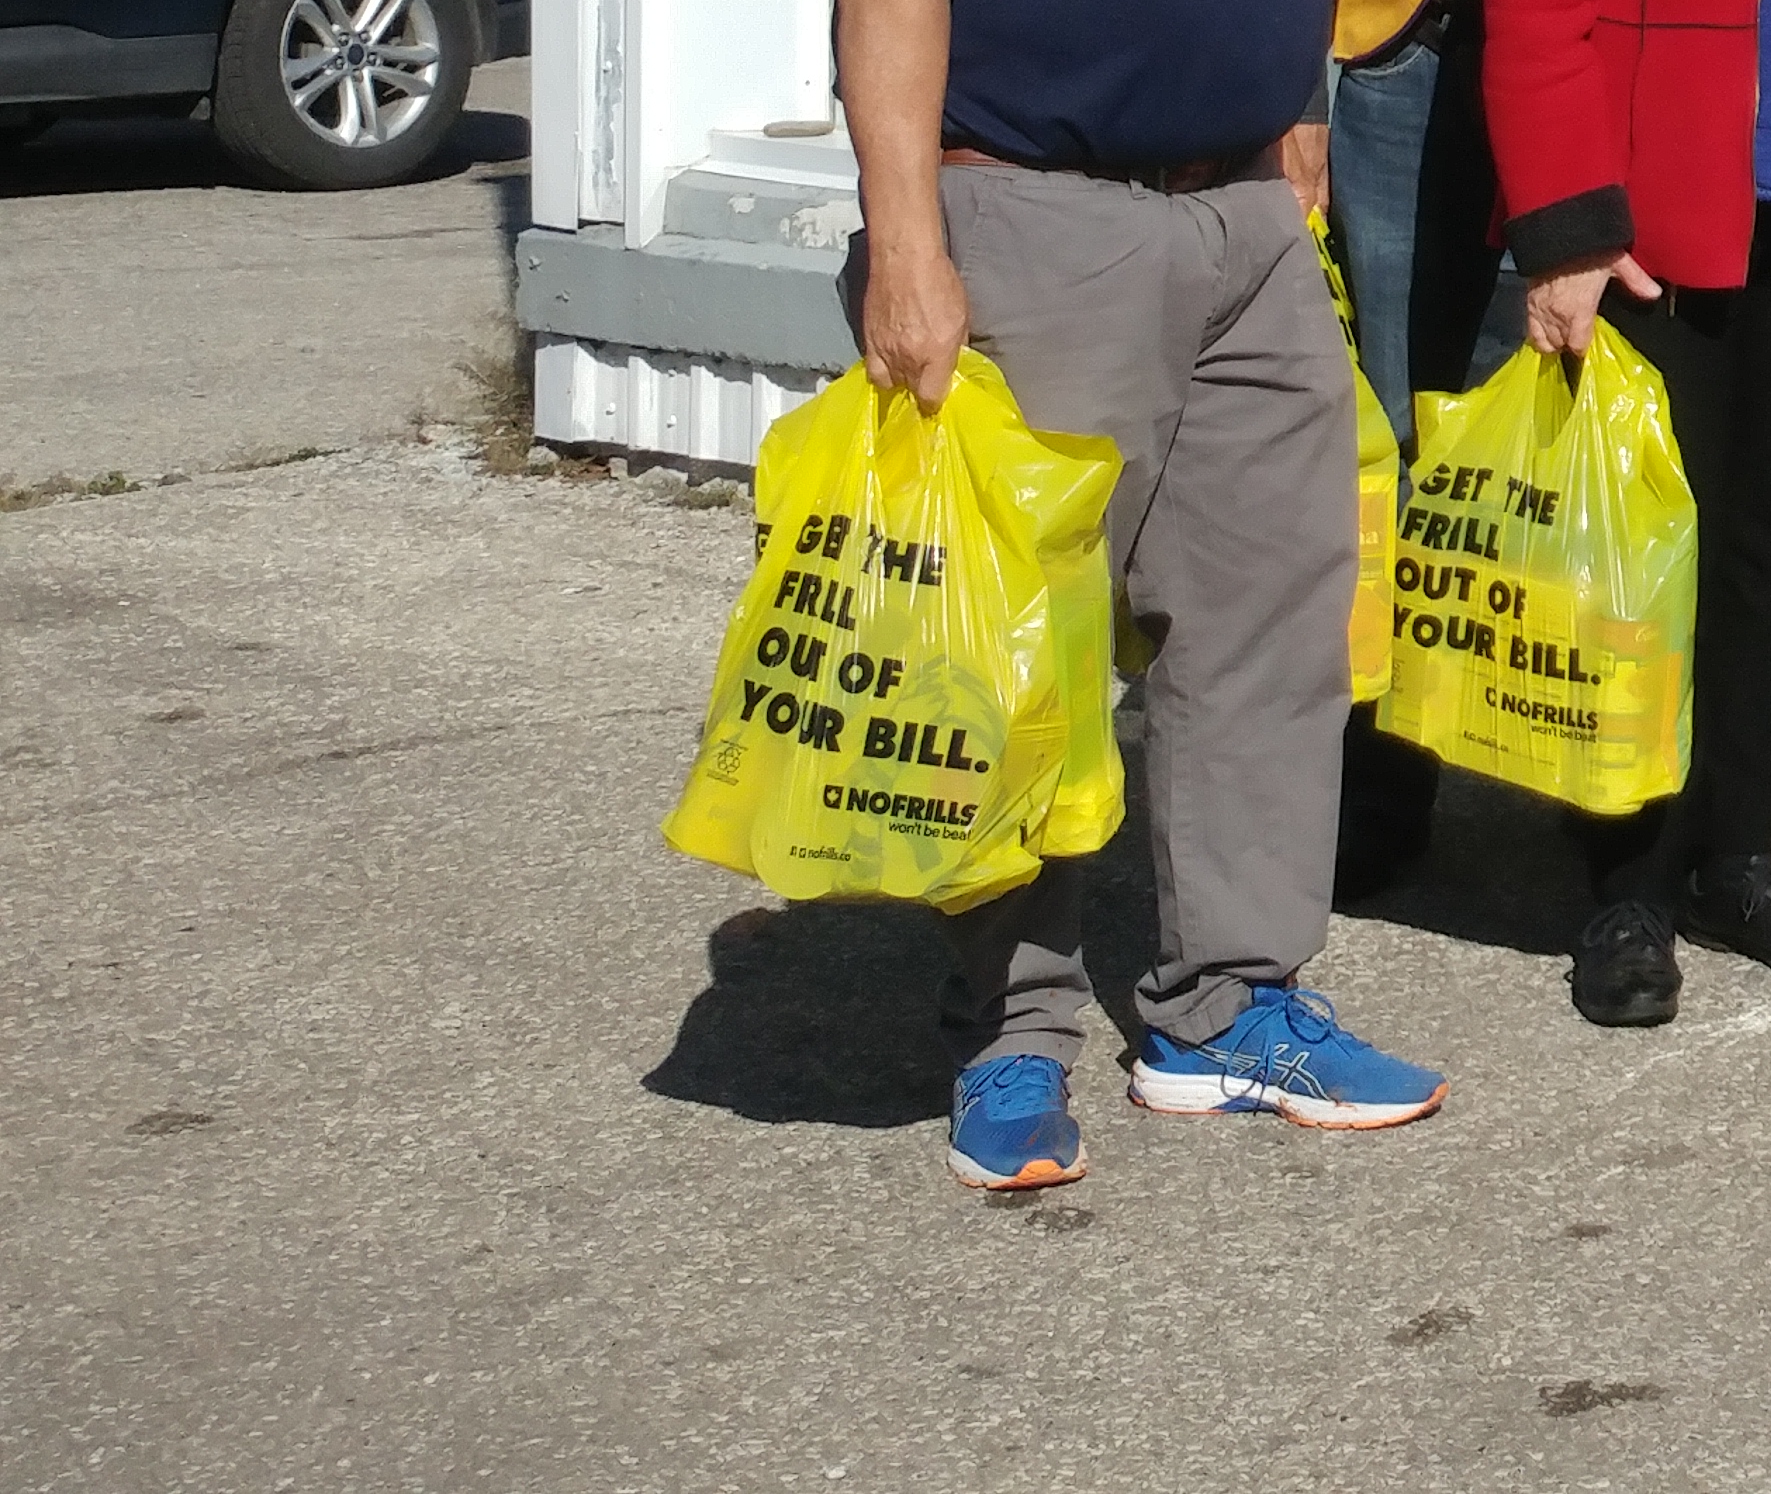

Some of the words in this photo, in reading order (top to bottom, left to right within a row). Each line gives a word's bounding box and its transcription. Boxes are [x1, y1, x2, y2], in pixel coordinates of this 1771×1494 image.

[1418, 463, 1494, 502] GET
[1504, 476, 1560, 526] THE
[1400, 507, 1500, 562] FRILL
[1395, 557, 1478, 602] OUT
[1488, 580, 1527, 619] OF
[1393, 602, 1497, 661] YOUR
[1509, 634, 1602, 686] BILL.
[838, 653, 907, 700] OF
[740, 679, 845, 754] YOUR
[863, 716, 990, 774] BILL.
[1501, 691, 1599, 731] NOFRILLS
[846, 787, 979, 826] NOFRILLS
[888, 820, 922, 837] won't
[923, 822, 940, 839] be
